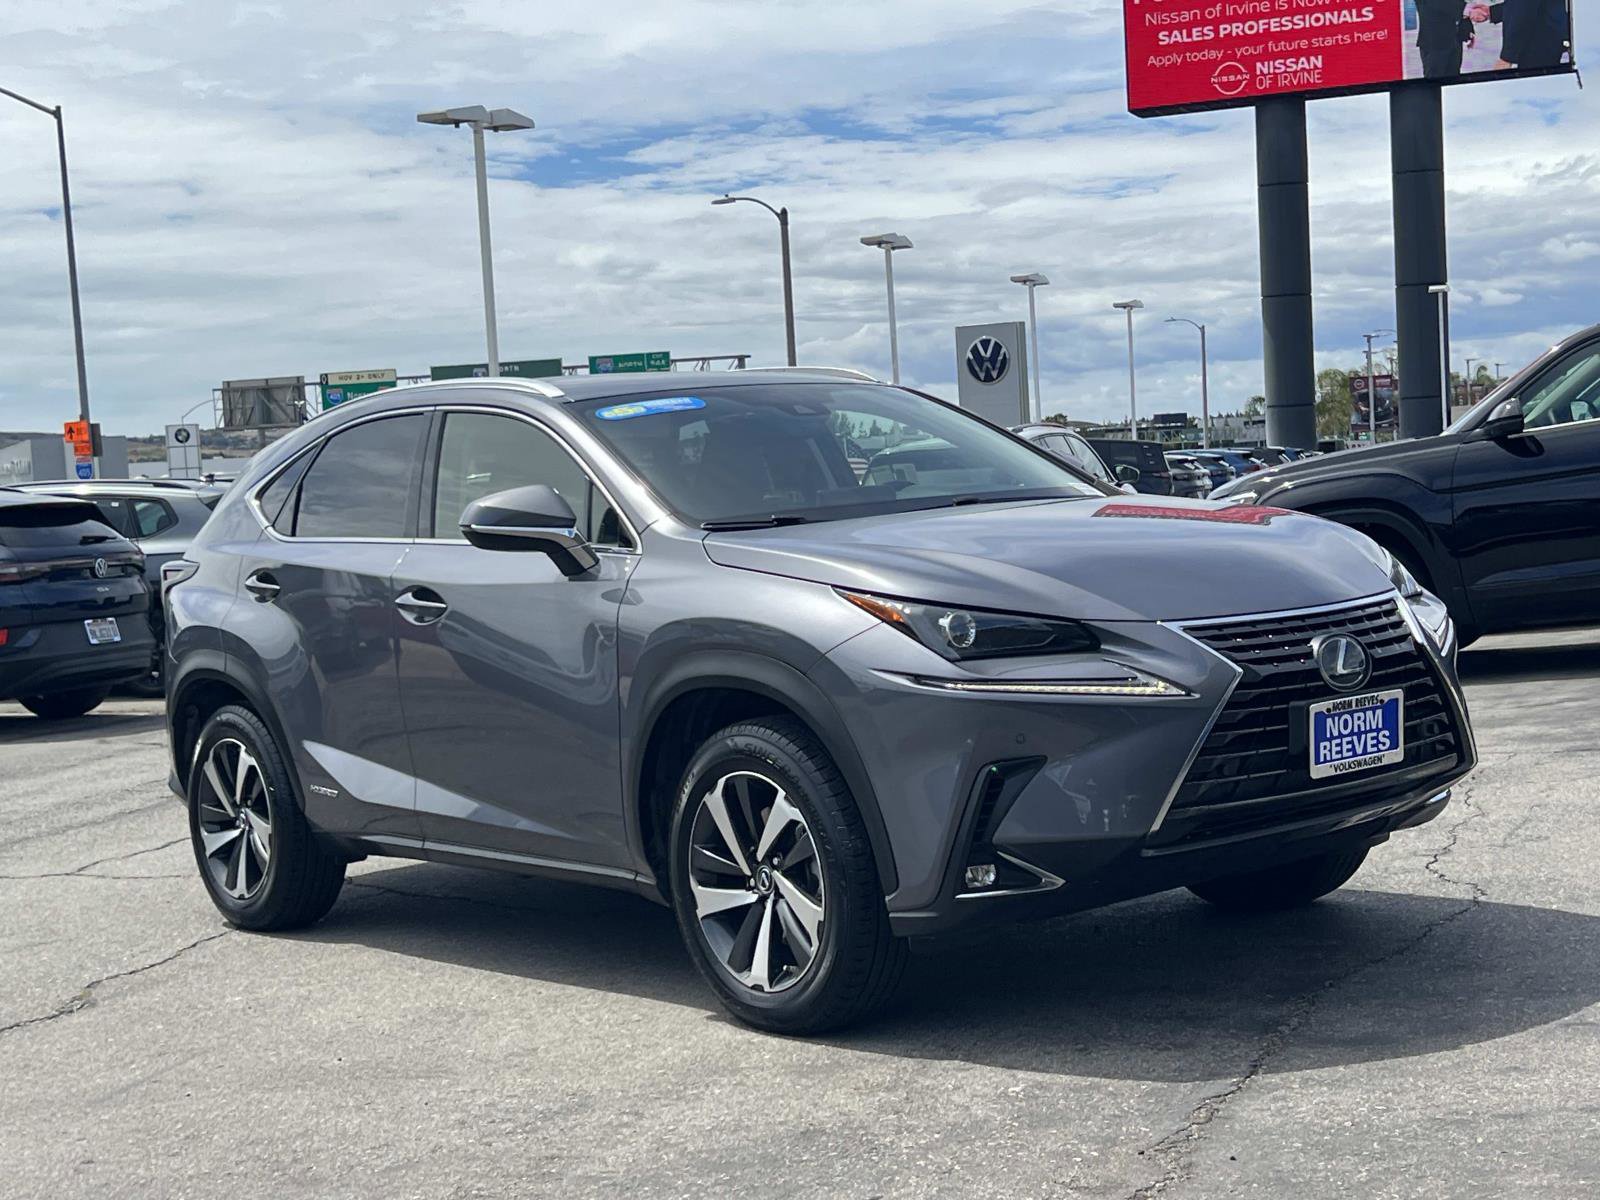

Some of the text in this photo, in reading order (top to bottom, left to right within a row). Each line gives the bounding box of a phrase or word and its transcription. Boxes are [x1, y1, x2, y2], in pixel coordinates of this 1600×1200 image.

[1145, 9, 1201, 26] Nissan
[1205, 3, 1223, 19] of
[1225, 0, 1271, 16] Irvine
[1275, 0, 1289, 10] is
[1158, 6, 1375, 45] SALES PROFESSIONALS
[1147, 53, 1184, 68] Apply
[1186, 48, 1224, 62] today
[1235, 44, 1265, 59] your
[1267, 39, 1309, 53] future
[1311, 33, 1352, 48] starts
[1353, 29, 1389, 43] here!
[1255, 55, 1323, 75] NISSAN
[1210, 73, 1251, 84] NISSAN
[1255, 69, 1323, 90] OF IRVINE
[1332, 694, 1380, 713] NORM REEVES
[1326, 708, 1383, 738] NORM
[1319, 730, 1391, 762] REEVES
